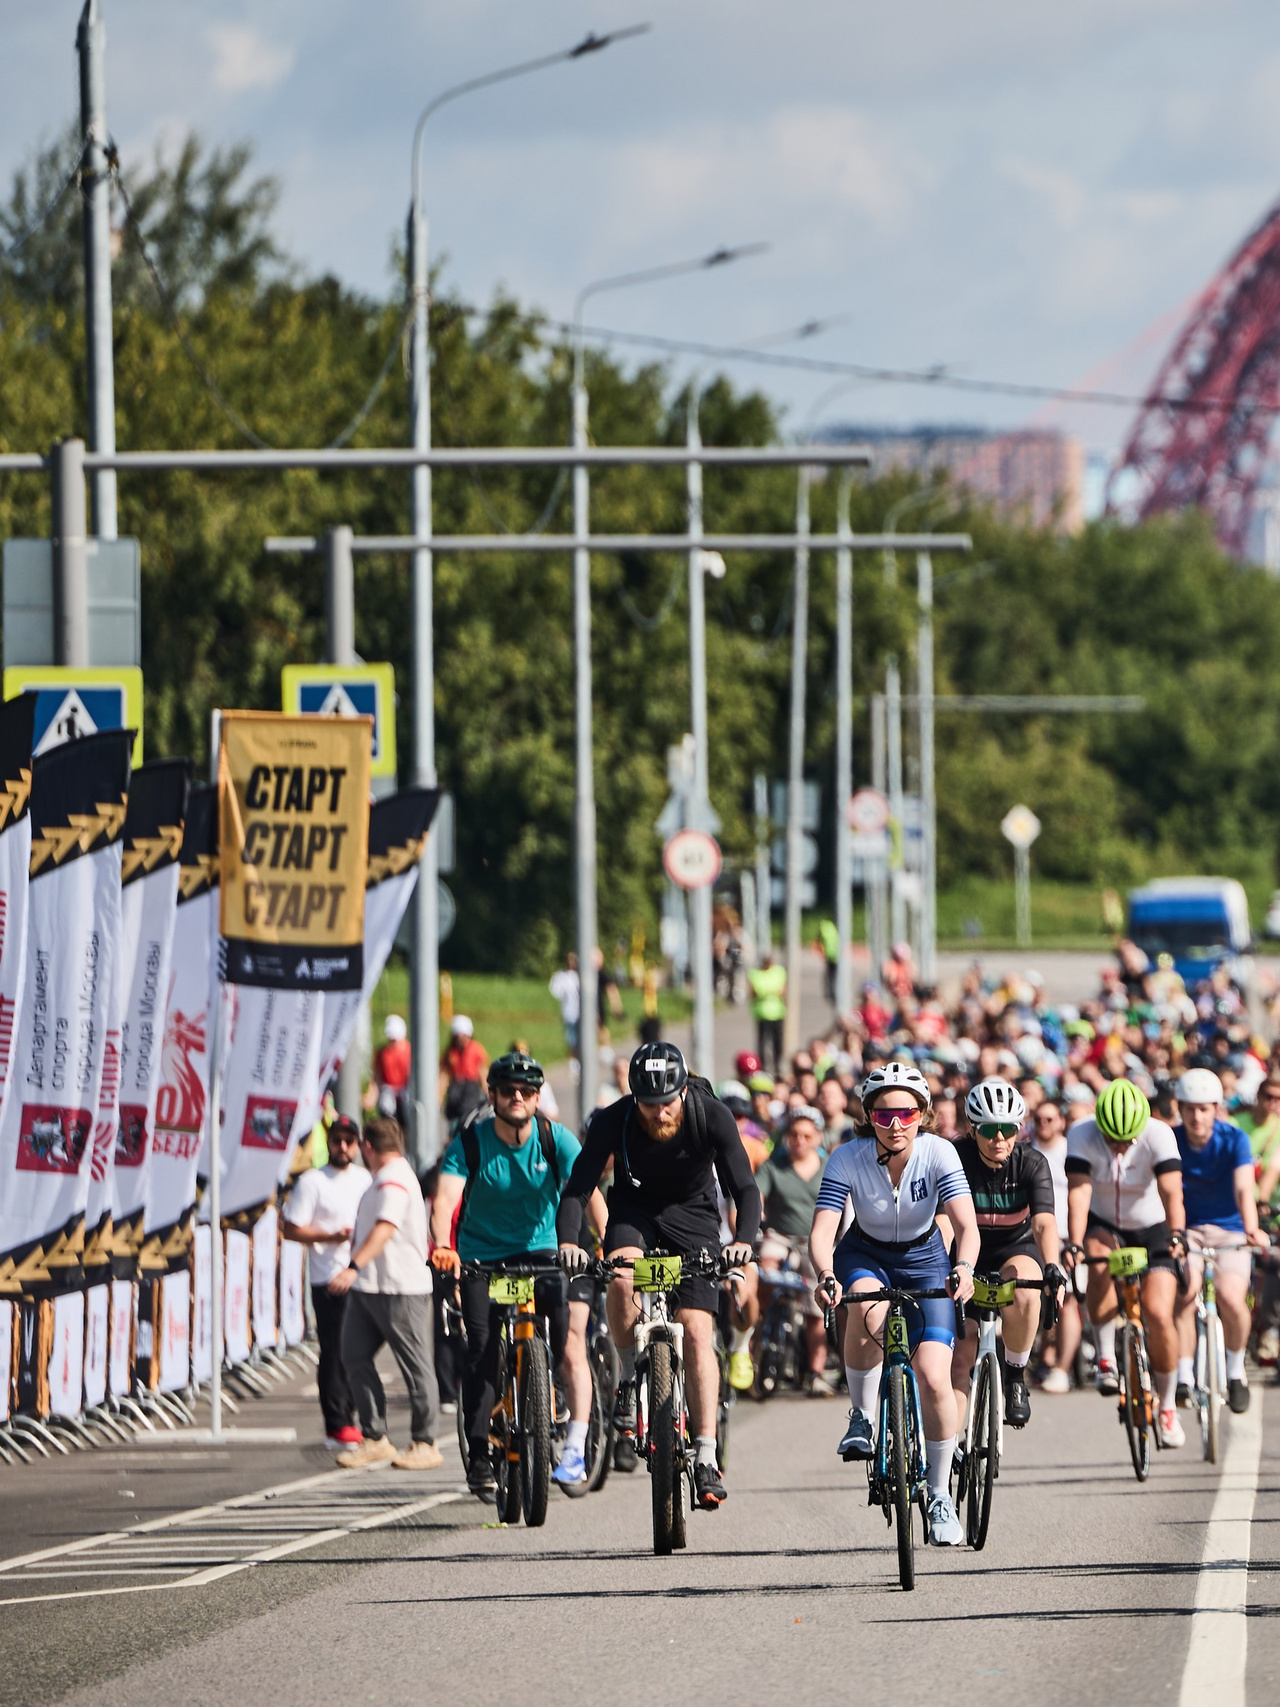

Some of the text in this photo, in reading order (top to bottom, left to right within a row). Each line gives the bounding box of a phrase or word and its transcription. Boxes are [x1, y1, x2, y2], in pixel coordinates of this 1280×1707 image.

[244, 765, 346, 813] СТАРТ
[242, 821, 347, 872] СТАРТ
[244, 880, 347, 932] СТАРТ
[26, 946, 50, 1091] Департамент
[75, 930, 99, 1094] города Москвы
[133, 940, 161, 1091] города Москвы
[50, 1017, 71, 1091] спорта
[506, 1283, 519, 1297] 15
[650, 1264, 666, 1281] 14
[986, 1290, 998, 1303] 2
[892, 1323, 903, 1342] 3
